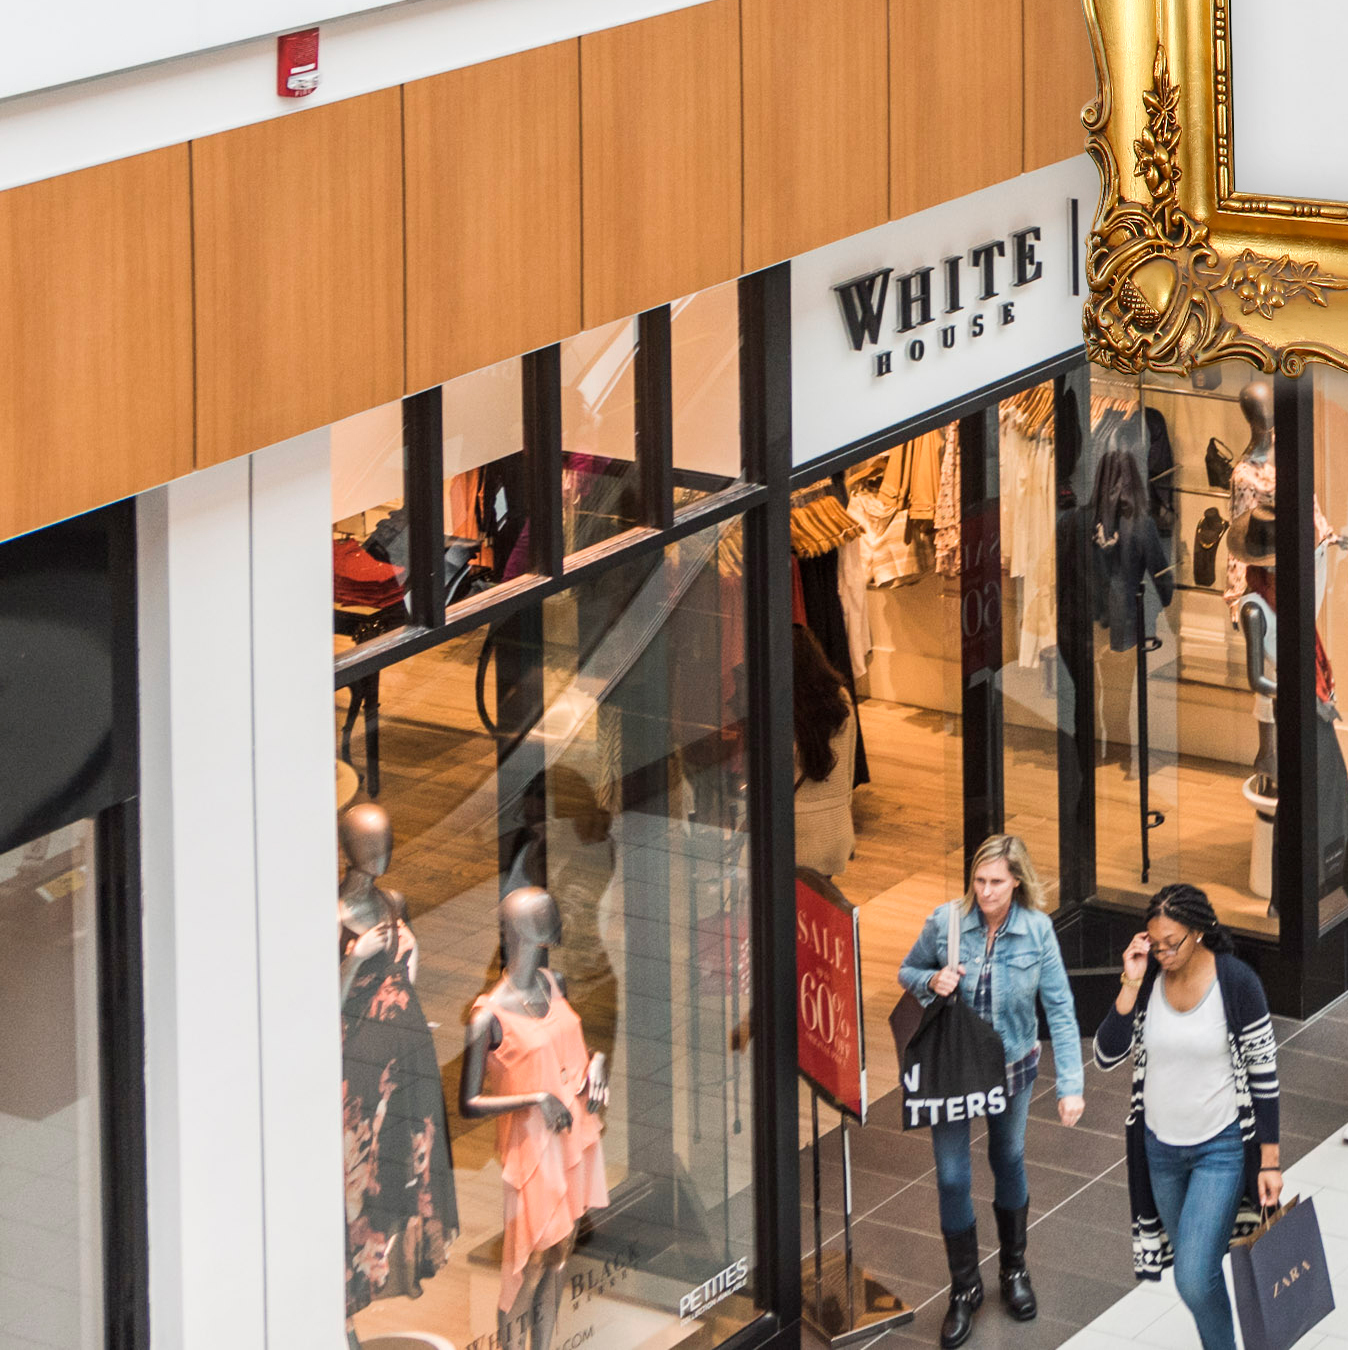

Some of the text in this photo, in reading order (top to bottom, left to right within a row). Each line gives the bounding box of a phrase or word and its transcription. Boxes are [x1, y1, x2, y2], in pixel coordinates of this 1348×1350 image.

[831, 226, 1043, 351] WHITE
[873, 301, 1016, 377] HOUSE
[798, 909, 848, 973] SALE
[801, 972, 850, 1043] 60%
[905, 1085, 1006, 1126] TTERS
[680, 1256, 748, 1318] PETITES
